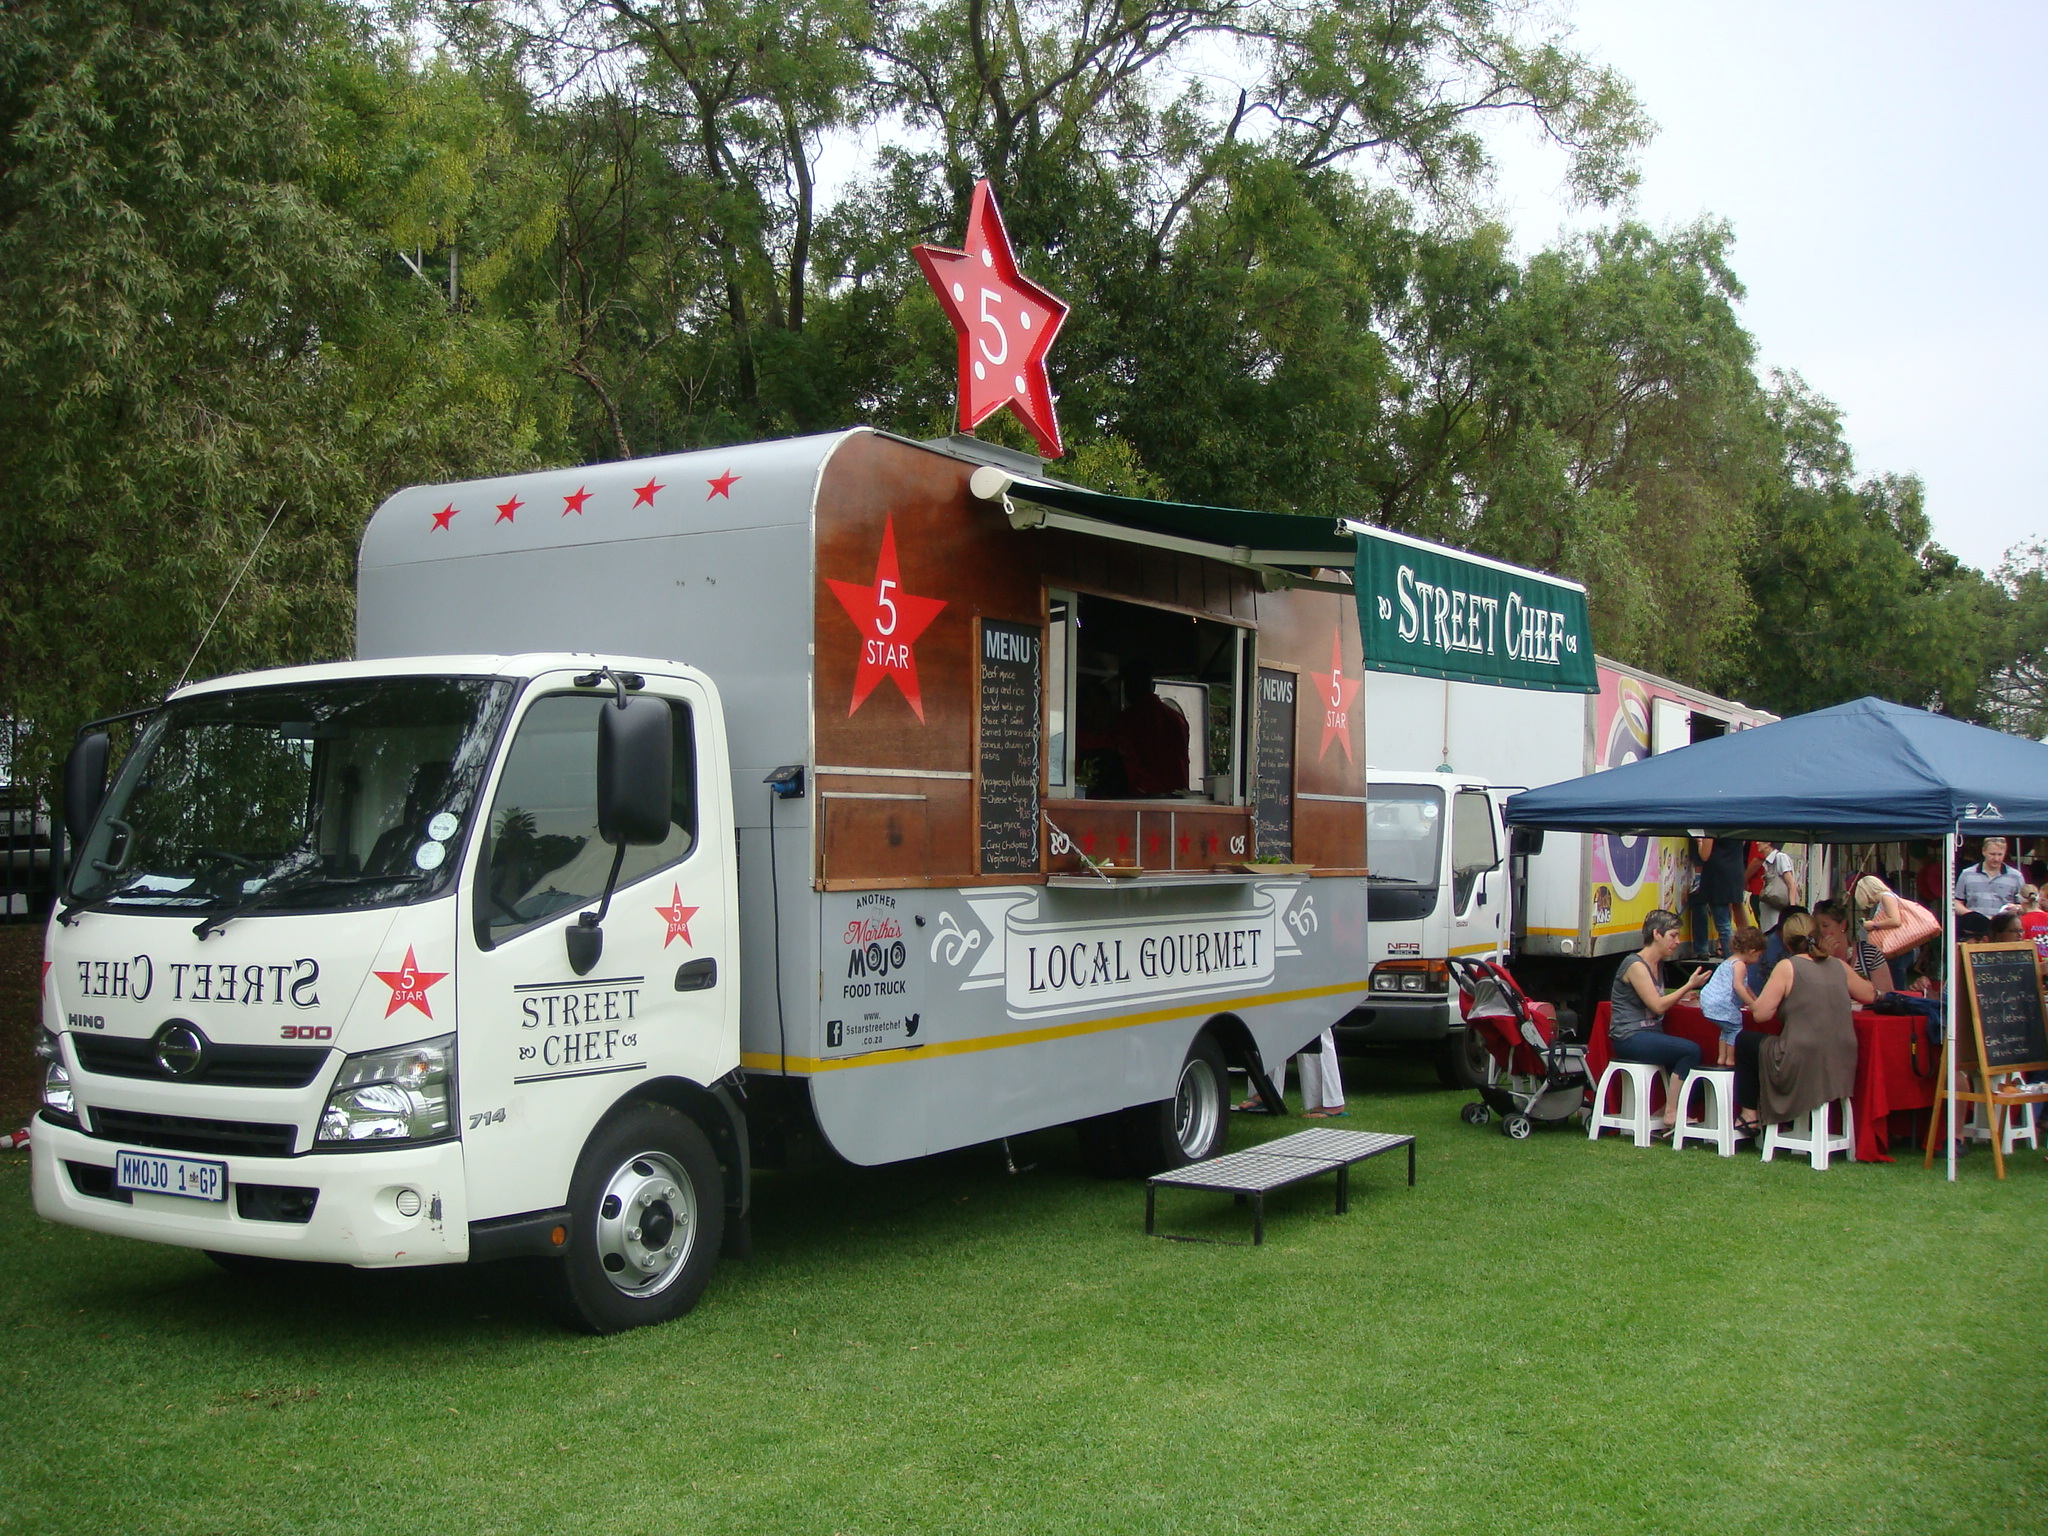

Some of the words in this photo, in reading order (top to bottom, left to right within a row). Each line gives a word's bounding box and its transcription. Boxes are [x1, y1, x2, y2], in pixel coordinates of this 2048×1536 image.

[979, 287, 1008, 366] 5
[875, 579, 897, 636] 5
[1396, 564, 1499, 655] STREET
[1504, 591, 1566, 665] CHEF
[867, 639, 909, 669] STAR
[986, 629, 1031, 664] MENU
[1263, 677, 1293, 704] NEWS
[1331, 669, 1341, 708] 5
[1327, 710, 1346, 729] STAR
[672, 902, 682, 922] 5
[856, 893, 896, 910] ANOTHER
[669, 923, 687, 933] STAR
[843, 917, 903, 953] Martha's
[847, 940, 906, 978] MOJO
[1028, 939, 1131, 994] LOCAL
[1139, 928, 1261, 980] GOURMET
[401, 967, 415, 990] 5
[843, 983, 871, 999] FOOD
[874, 980, 906, 996] TRUCK
[395, 990, 423, 1001] STAR
[522, 988, 640, 1030] STREET
[68, 1013, 105, 1030] HINO
[280, 1025, 333, 1040] 300
[845, 1019, 901, 1036] 5starstreetchef
[863, 1012, 881, 1021] www.
[543, 1029, 620, 1068] CHEF
[861, 1035, 883, 1046] .co.za
[469, 1107, 506, 1130] 714
[123, 1157, 169, 1189] MMOJO
[178, 1164, 187, 1192] 1
[200, 1167, 217, 1195] GP
